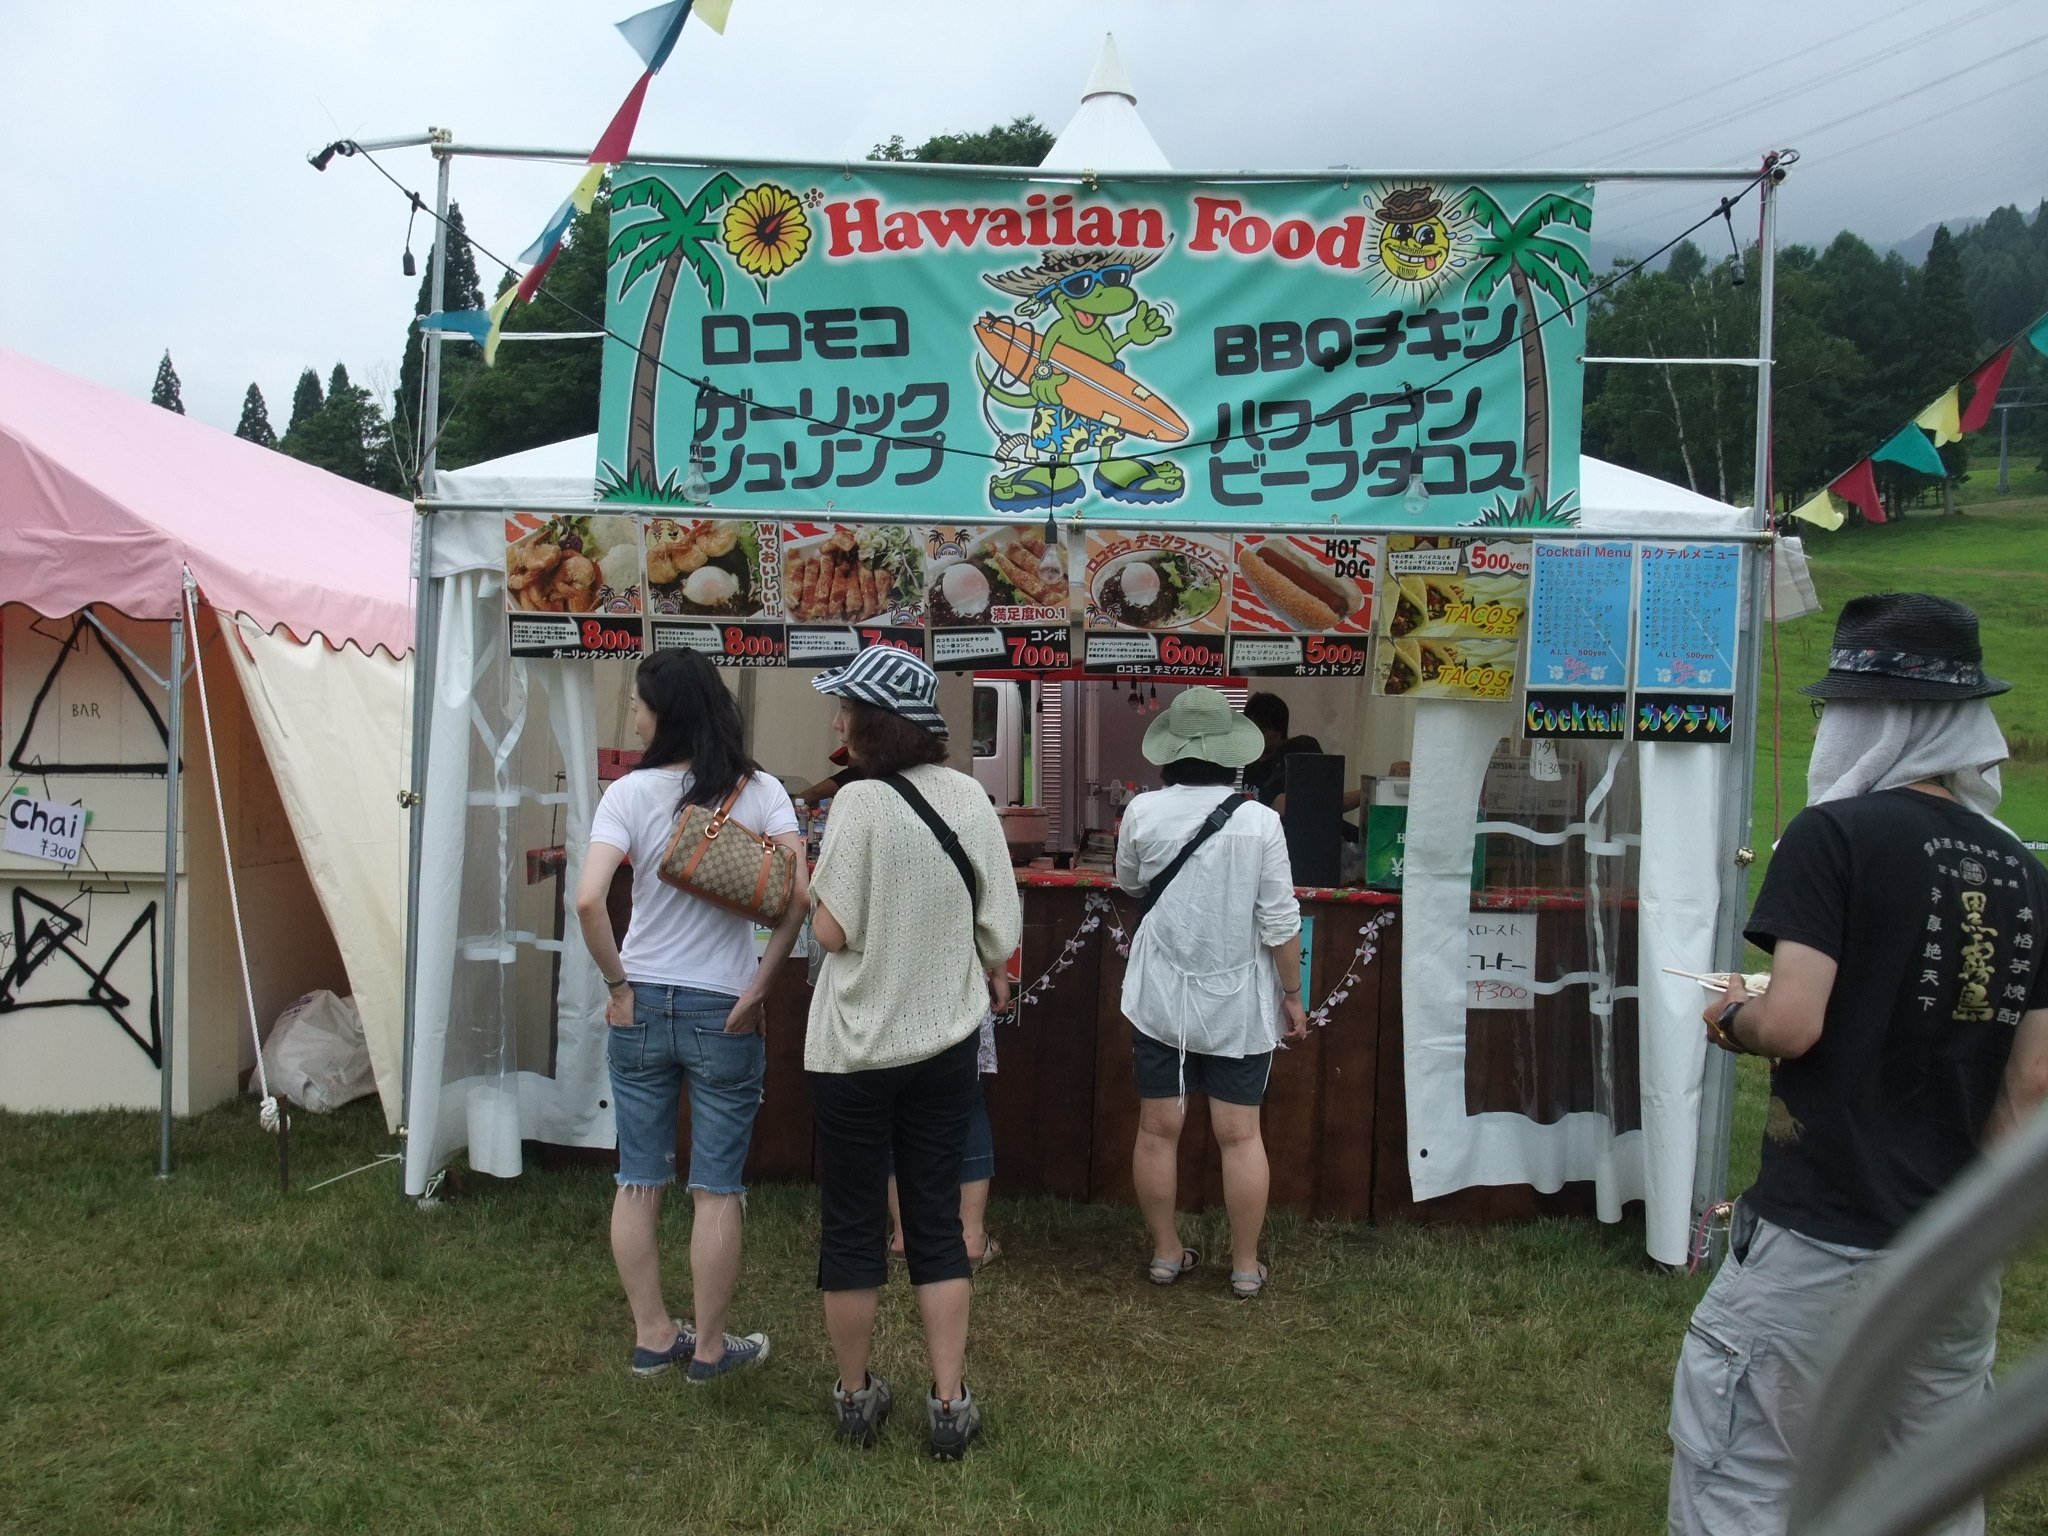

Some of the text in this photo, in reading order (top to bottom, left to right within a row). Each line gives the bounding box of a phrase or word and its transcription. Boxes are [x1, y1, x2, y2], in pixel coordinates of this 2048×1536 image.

[824, 194, 1366, 269] Hawaiian Food
[701, 307, 909, 366] ロコモコ
[1214, 304, 1518, 376] BBQチキン
[697, 382, 950, 442] ガーリック
[1211, 386, 1483, 454] ハワイアン
[700, 431, 946, 495] シュリンプ
[1208, 440, 1526, 507] ビーフタコス
[1086, 533, 1229, 579] ロコモコ デミグラスソース
[1325, 539, 1361, 558] HOT
[1471, 546, 1529, 570] 500yen
[1536, 546, 1631, 558] Cocktail Menu
[1642, 548, 1739, 559] カクテルメニュー
[1335, 560, 1370, 579] DOG
[992, 606, 1067, 621] 満足度NO.1
[1446, 605, 1519, 625] TACOS
[582, 620, 644, 650] 800円
[724, 626, 786, 656] 800円
[1007, 637, 1069, 667] 700円
[1160, 635, 1223, 667] 600円
[1306, 636, 1364, 666] 500円
[1686, 652, 1714, 660] 500yen
[1116, 664, 1223, 677] ロコモコ デミグラスソース
[1295, 665, 1364, 676] ホットドッグ
[1439, 667, 1510, 687] TACOS
[72, 703, 101, 718] BAR
[1527, 700, 1626, 733] Cocktail
[1637, 702, 1732, 734] カクテル
[10, 799, 78, 838] Chai
[41, 838, 77, 860] ¥300
[1474, 980, 1528, 1002] ¥300
